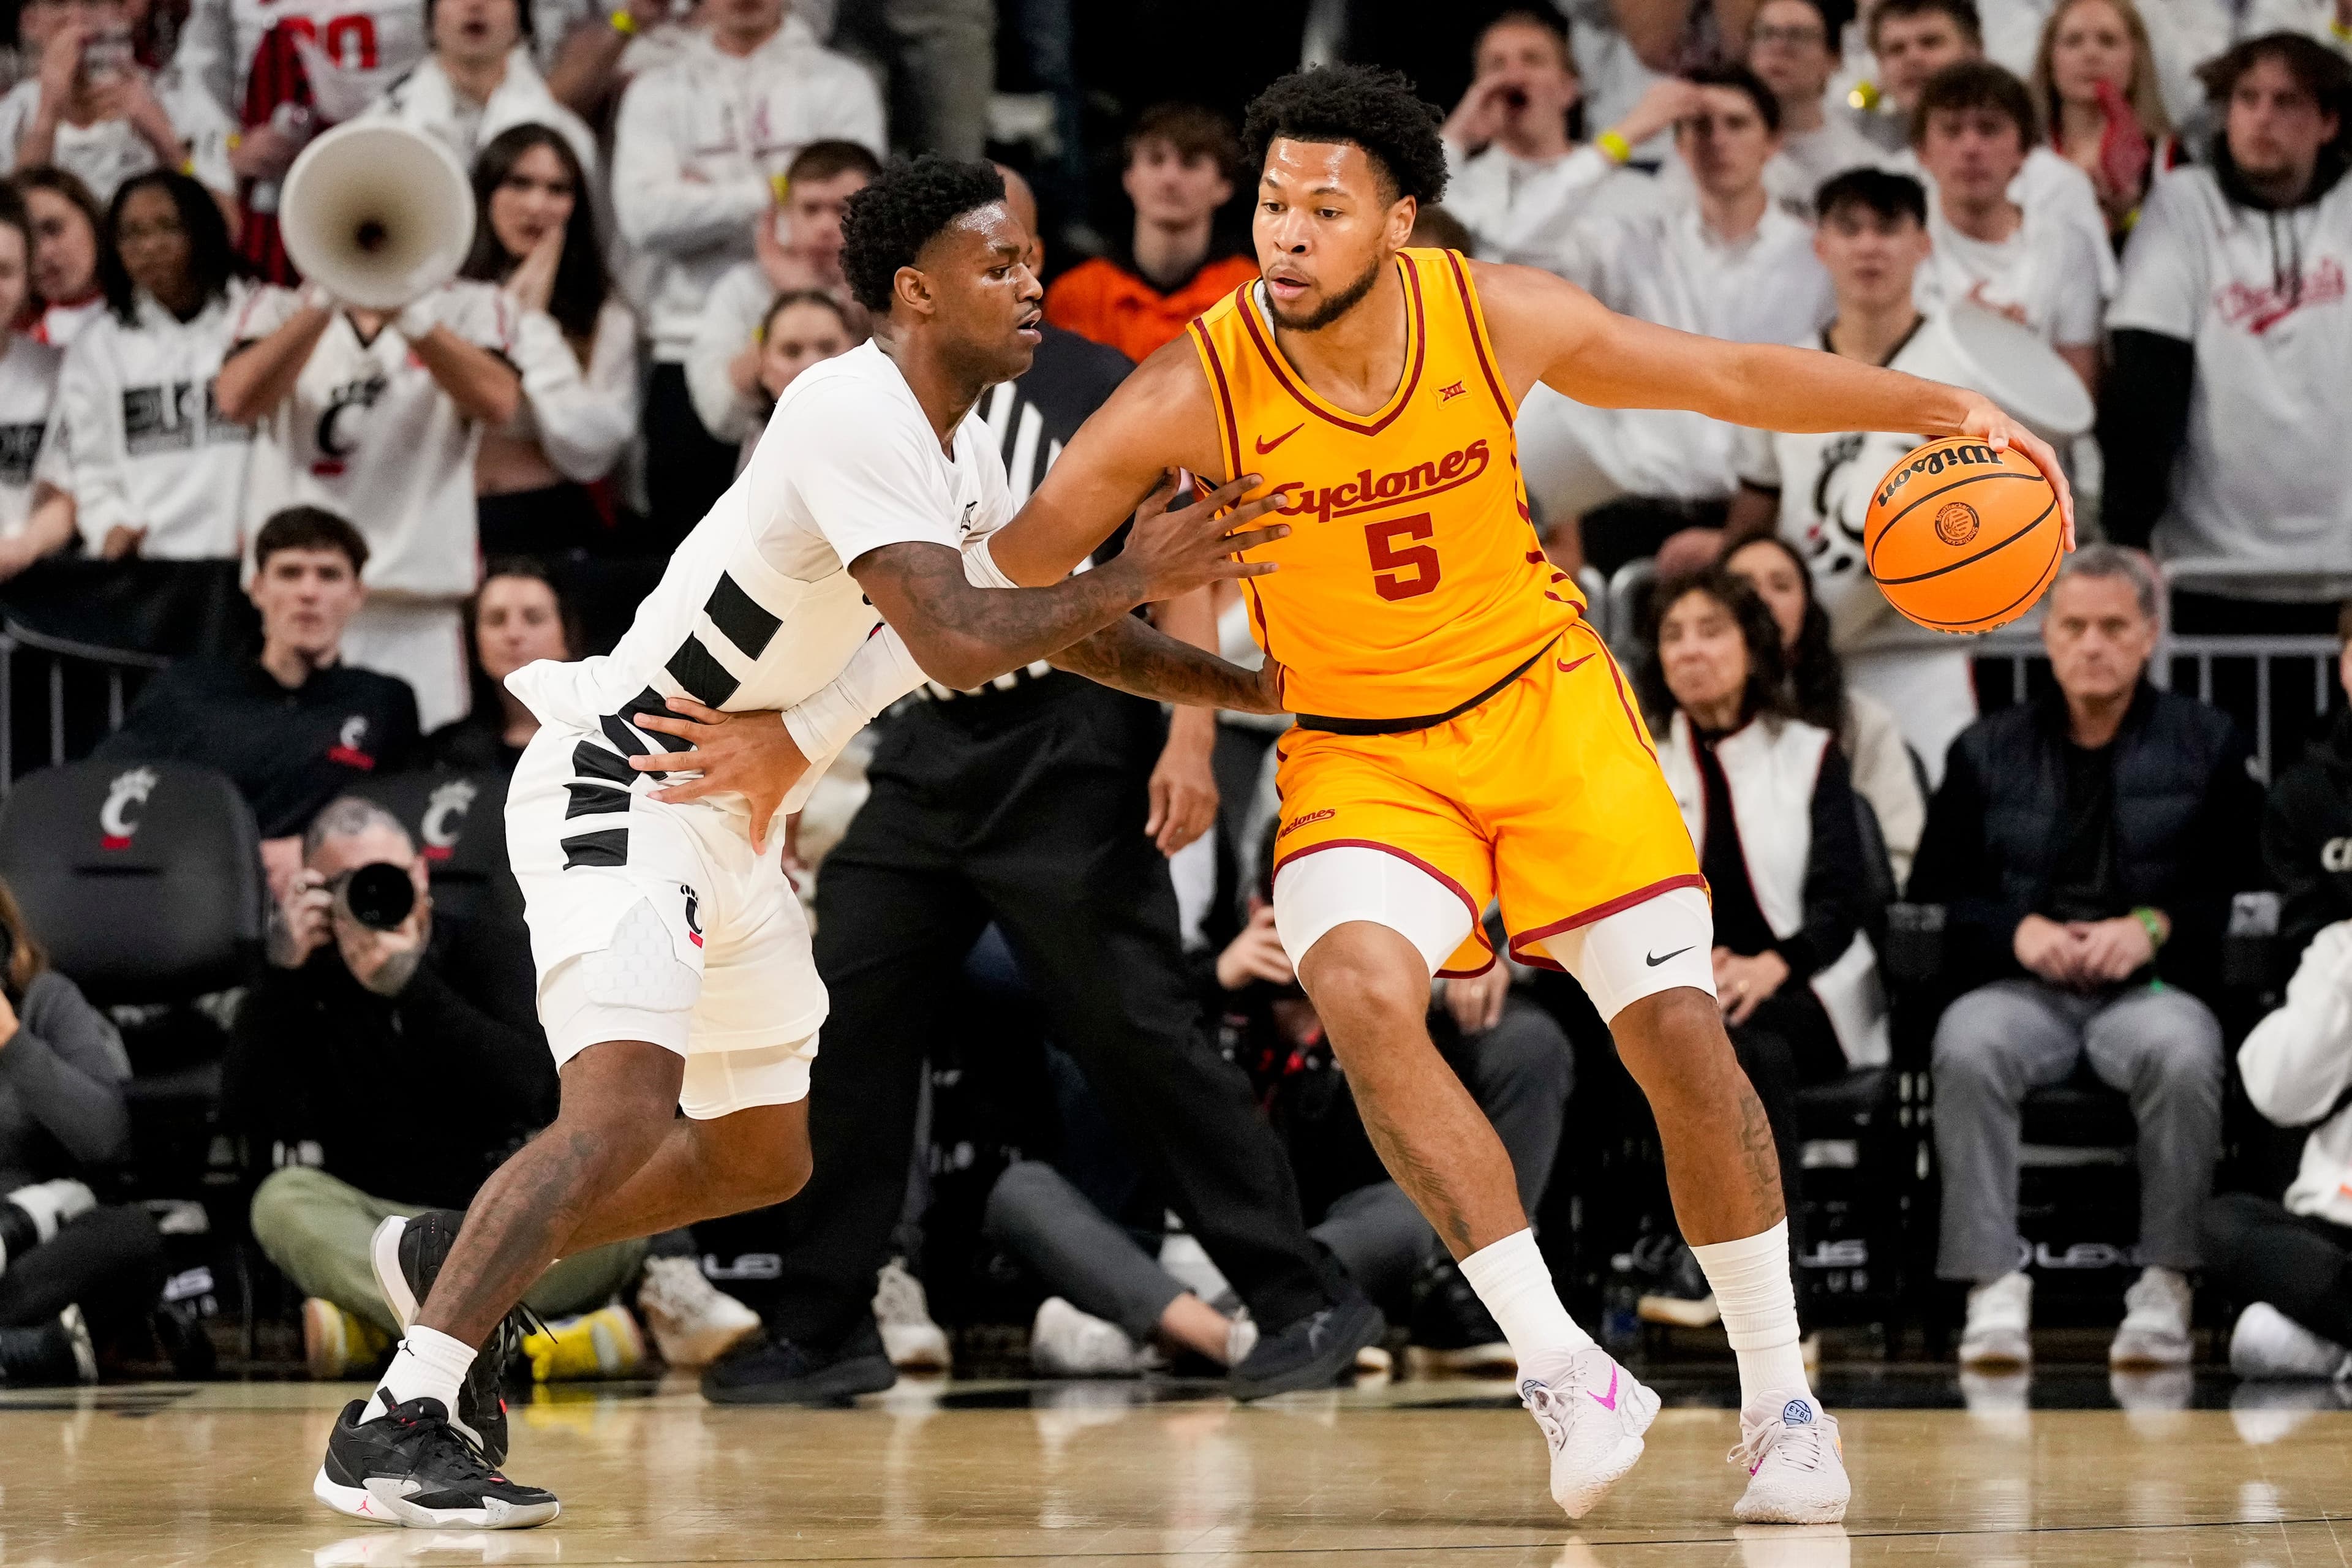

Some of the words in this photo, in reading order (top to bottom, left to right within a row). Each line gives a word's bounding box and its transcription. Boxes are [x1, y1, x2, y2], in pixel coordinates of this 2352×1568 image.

[1270, 439, 1490, 523] Cyclones
[1876, 445, 2003, 507] Wilson
[1364, 512, 1441, 602] 5
[1789, 1405, 1808, 1422] EYBL
